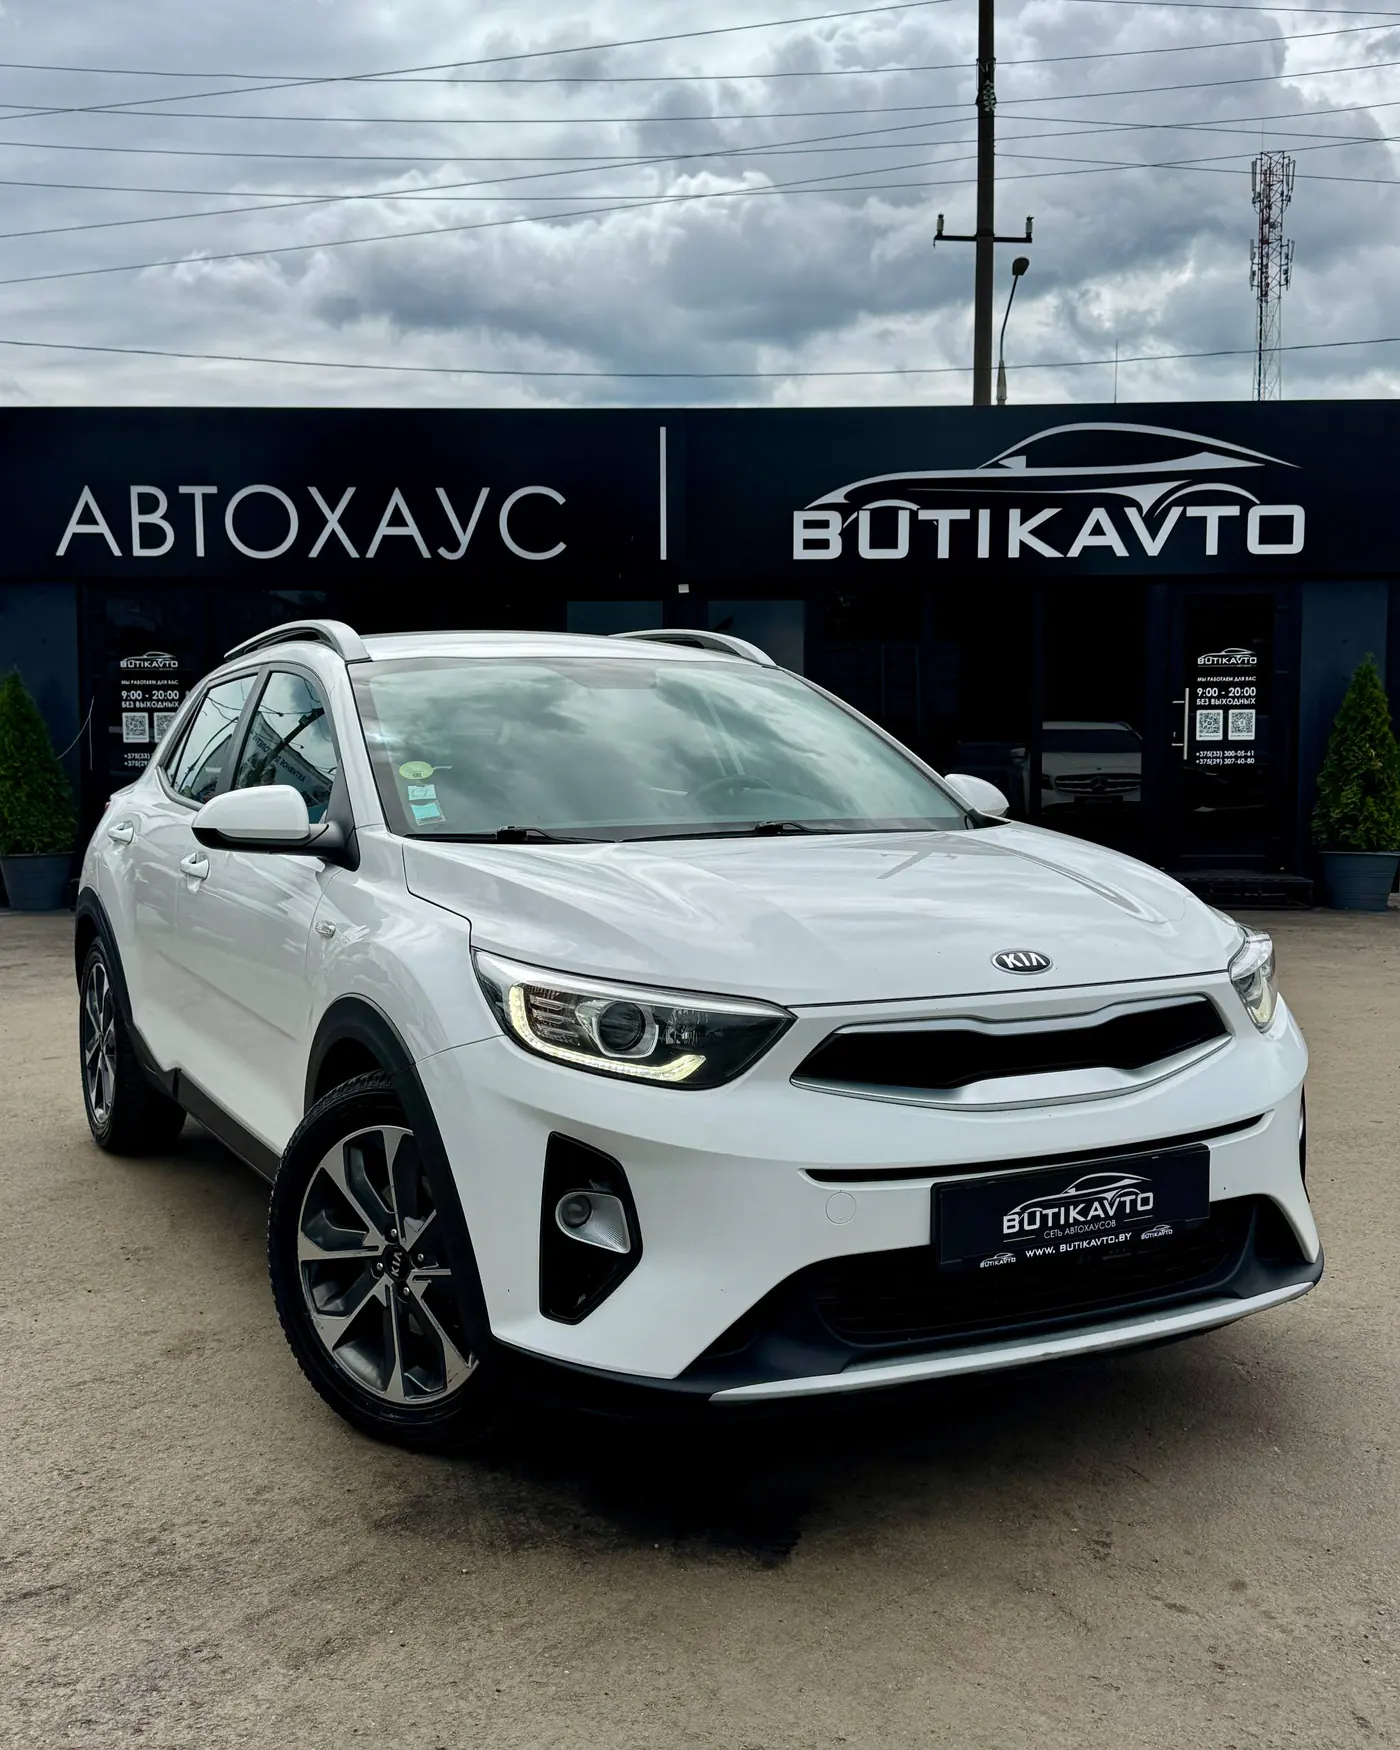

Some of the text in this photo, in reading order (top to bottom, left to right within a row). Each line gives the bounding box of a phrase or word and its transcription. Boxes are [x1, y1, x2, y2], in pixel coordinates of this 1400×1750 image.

[55, 484, 567, 560] АВТОХАУС
[793, 504, 1306, 560] BUTIKAVTO
[120, 660, 178, 668] BUTIKAVTO
[1197, 656, 1257, 665] BUTIKAVTO
[121, 690, 142, 700] 9:00
[152, 690, 179, 699] 20:00
[1196, 687, 1218, 697] 9:00
[1228, 687, 1256, 696] 20:00
[1000, 952, 1047, 969] KIA
[1003, 1192, 1153, 1234] BUTIKAVTO
[1043, 1219, 1116, 1239] СЕТЬ АВТОХАУСОВ
[391, 1252, 403, 1277] KIA
